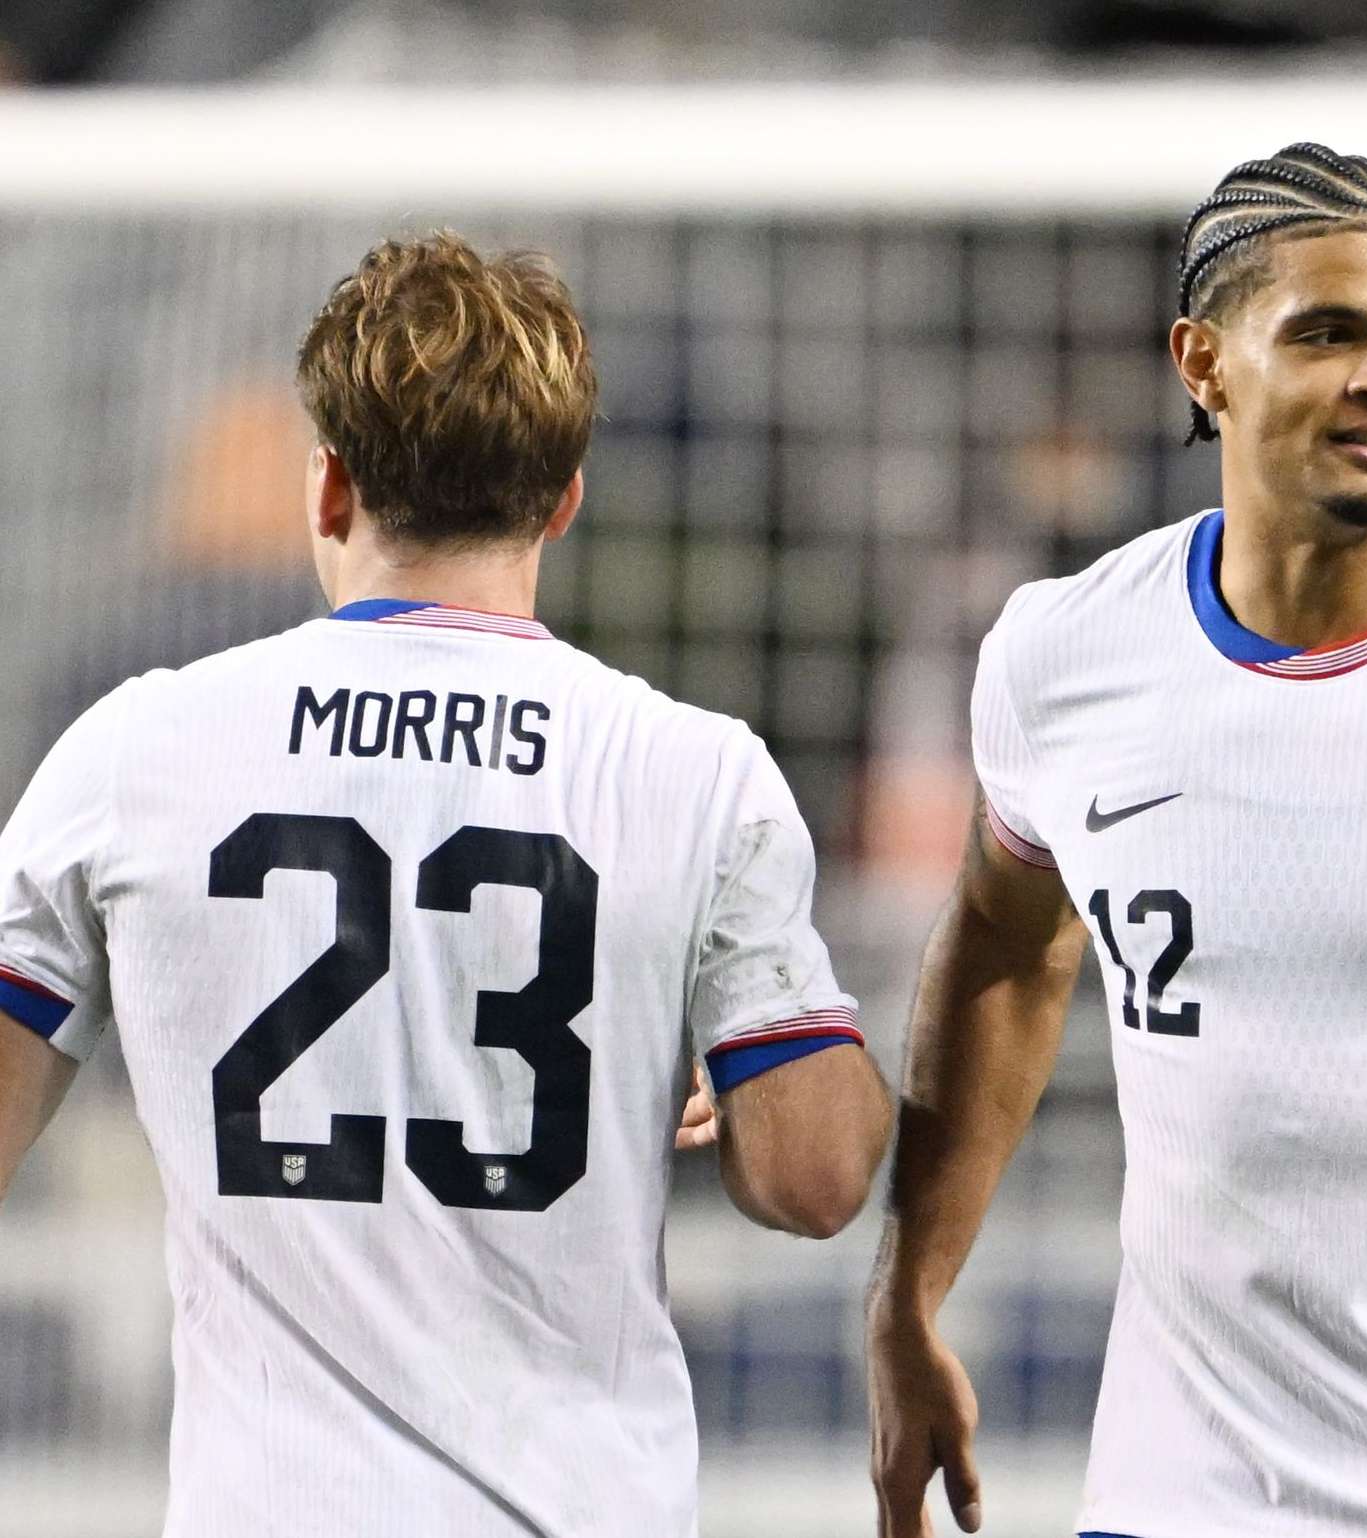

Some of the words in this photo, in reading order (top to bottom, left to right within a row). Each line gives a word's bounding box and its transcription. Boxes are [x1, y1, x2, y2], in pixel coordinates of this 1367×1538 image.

[289, 686, 550, 775] MORRIS
[1088, 889, 1201, 1037] 12
[208, 812, 599, 1212] 23
[284, 1156, 304, 1169] USA
[486, 1167, 505, 1180] USA
